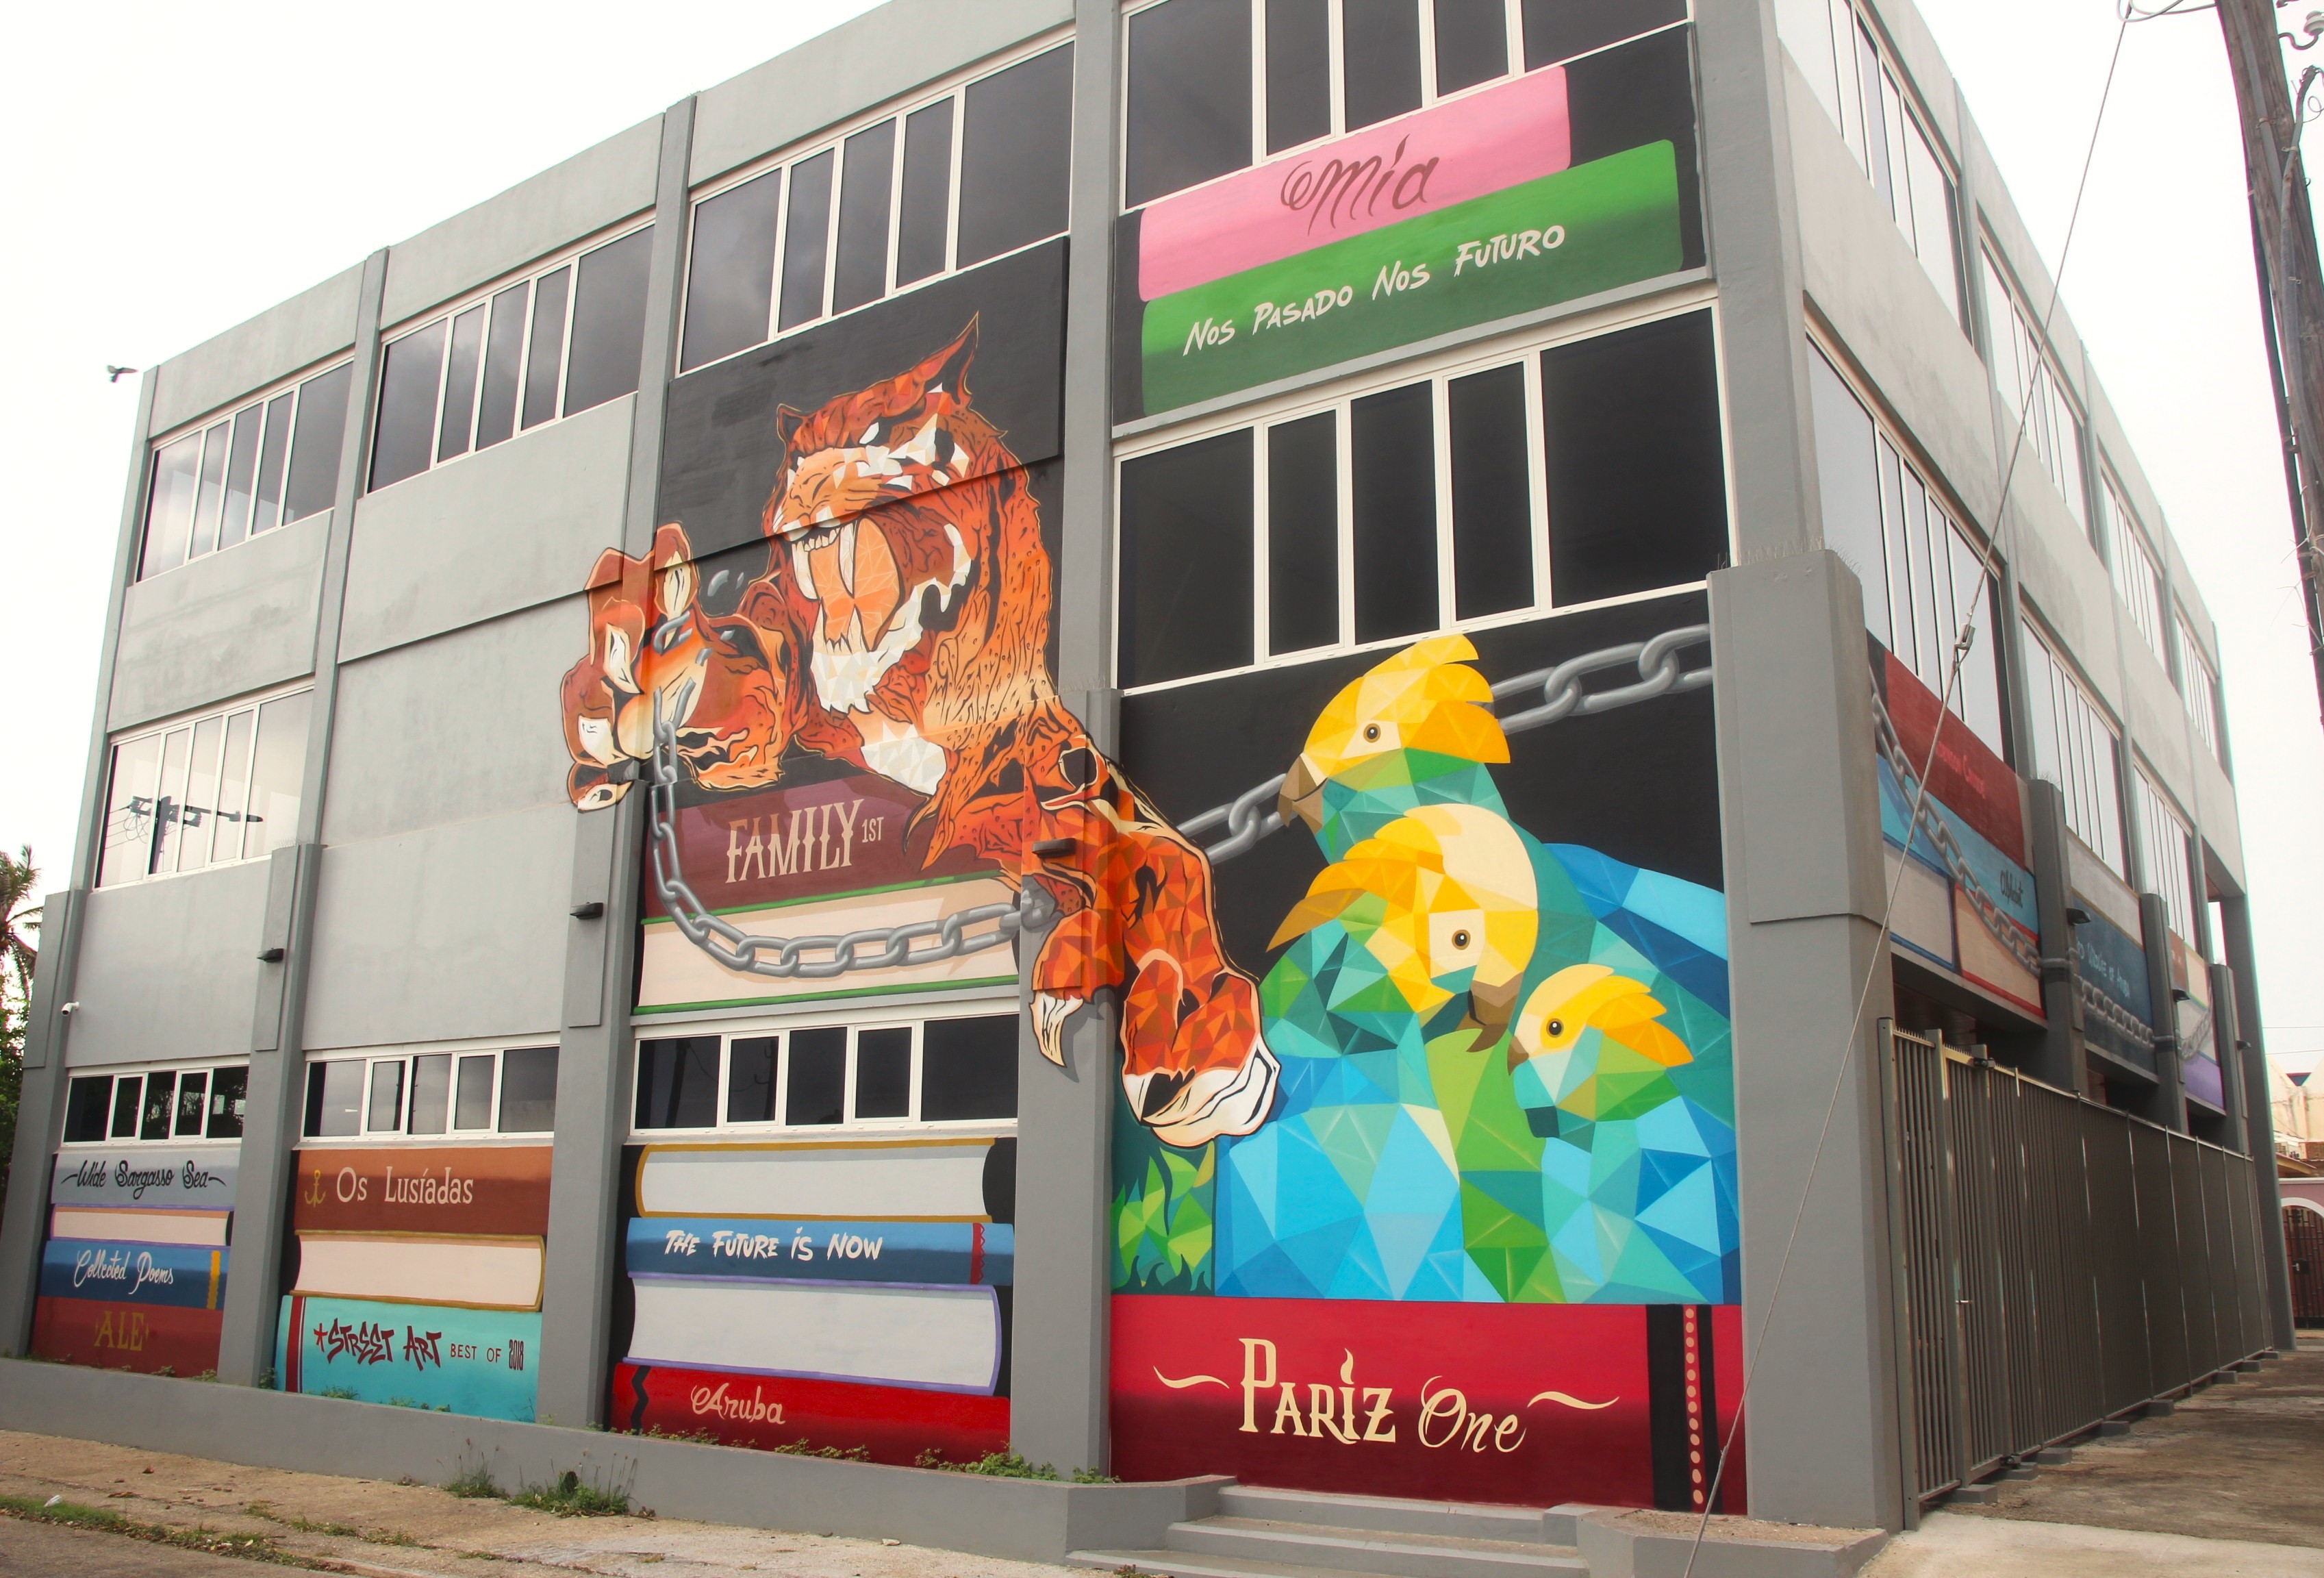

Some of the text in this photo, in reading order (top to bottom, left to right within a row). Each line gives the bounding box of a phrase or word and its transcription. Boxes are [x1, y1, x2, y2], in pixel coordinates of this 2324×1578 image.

[1252, 284, 1354, 336] PASADO
[1453, 224, 1566, 277] FUTURO
[724, 798, 885, 884] FAMILY 1ST
[77, 1160, 208, 1200] Wide Sargasso Sea
[336, 1166, 474, 1204] Os Lusíadas
[664, 1230, 700, 1256] THE
[712, 1230, 779, 1260] FUTURE
[826, 1232, 883, 1261] NOW
[73, 1249, 174, 1295] Collected Poems
[94, 1311, 144, 1351] ALE
[326, 1317, 524, 1371] STREET ART BEST OF 2018
[690, 1382, 786, 1425] Aruba
[1417, 1374, 1528, 1453] One
